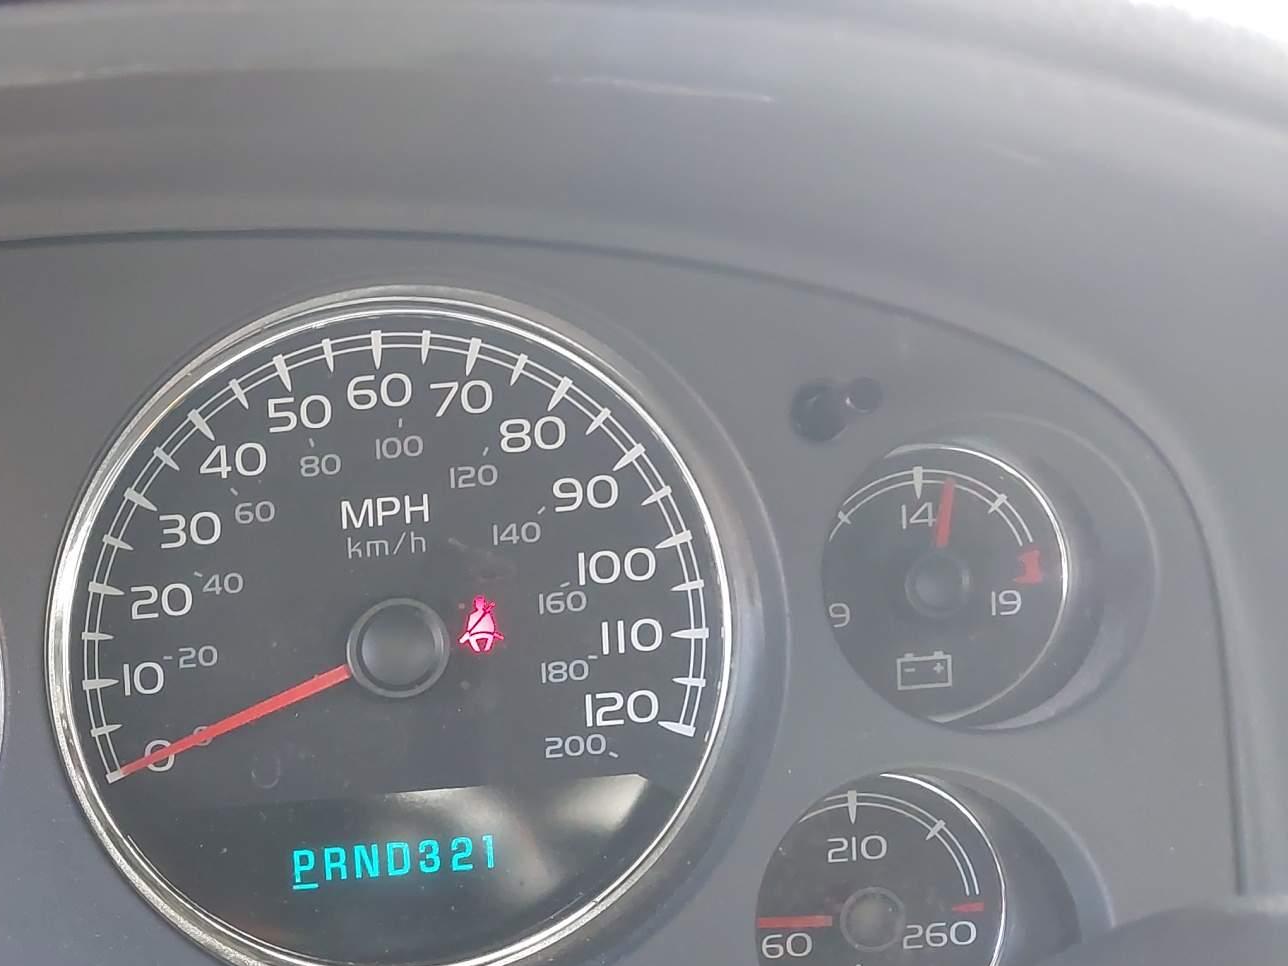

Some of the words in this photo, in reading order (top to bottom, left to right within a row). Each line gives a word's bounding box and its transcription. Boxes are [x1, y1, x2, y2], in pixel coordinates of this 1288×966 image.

[345, 372, 412, 410] 60
[429, 379, 493, 417] 70
[266, 395, 332, 433] 50
[373, 436, 424, 460] 100
[499, 416, 566, 453] 80
[198, 443, 267, 480] 40
[298, 453, 341, 477] 80
[448, 464, 498, 489] 120
[551, 475, 619, 512] 90
[233, 501, 275, 525] 60
[340, 494, 430, 529] MPH
[900, 503, 937, 529] 14
[158, 511, 222, 549] 30
[492, 522, 542, 546] 140
[346, 531, 427, 560] km/h
[577, 548, 657, 586] 100
[201, 572, 244, 596] 40
[129, 583, 193, 620] 20
[537, 590, 587, 615] 160
[990, 589, 1023, 617] 19
[600, 618, 663, 654] 110
[177, 645, 218, 669] 20
[540, 659, 588, 683] 180
[122, 663, 165, 696] 10
[584, 690, 660, 727] 120
[144, 740, 175, 772] 0
[543, 734, 606, 759] 200
[827, 835, 888, 864] 210
[902, 920, 977, 949] 260
